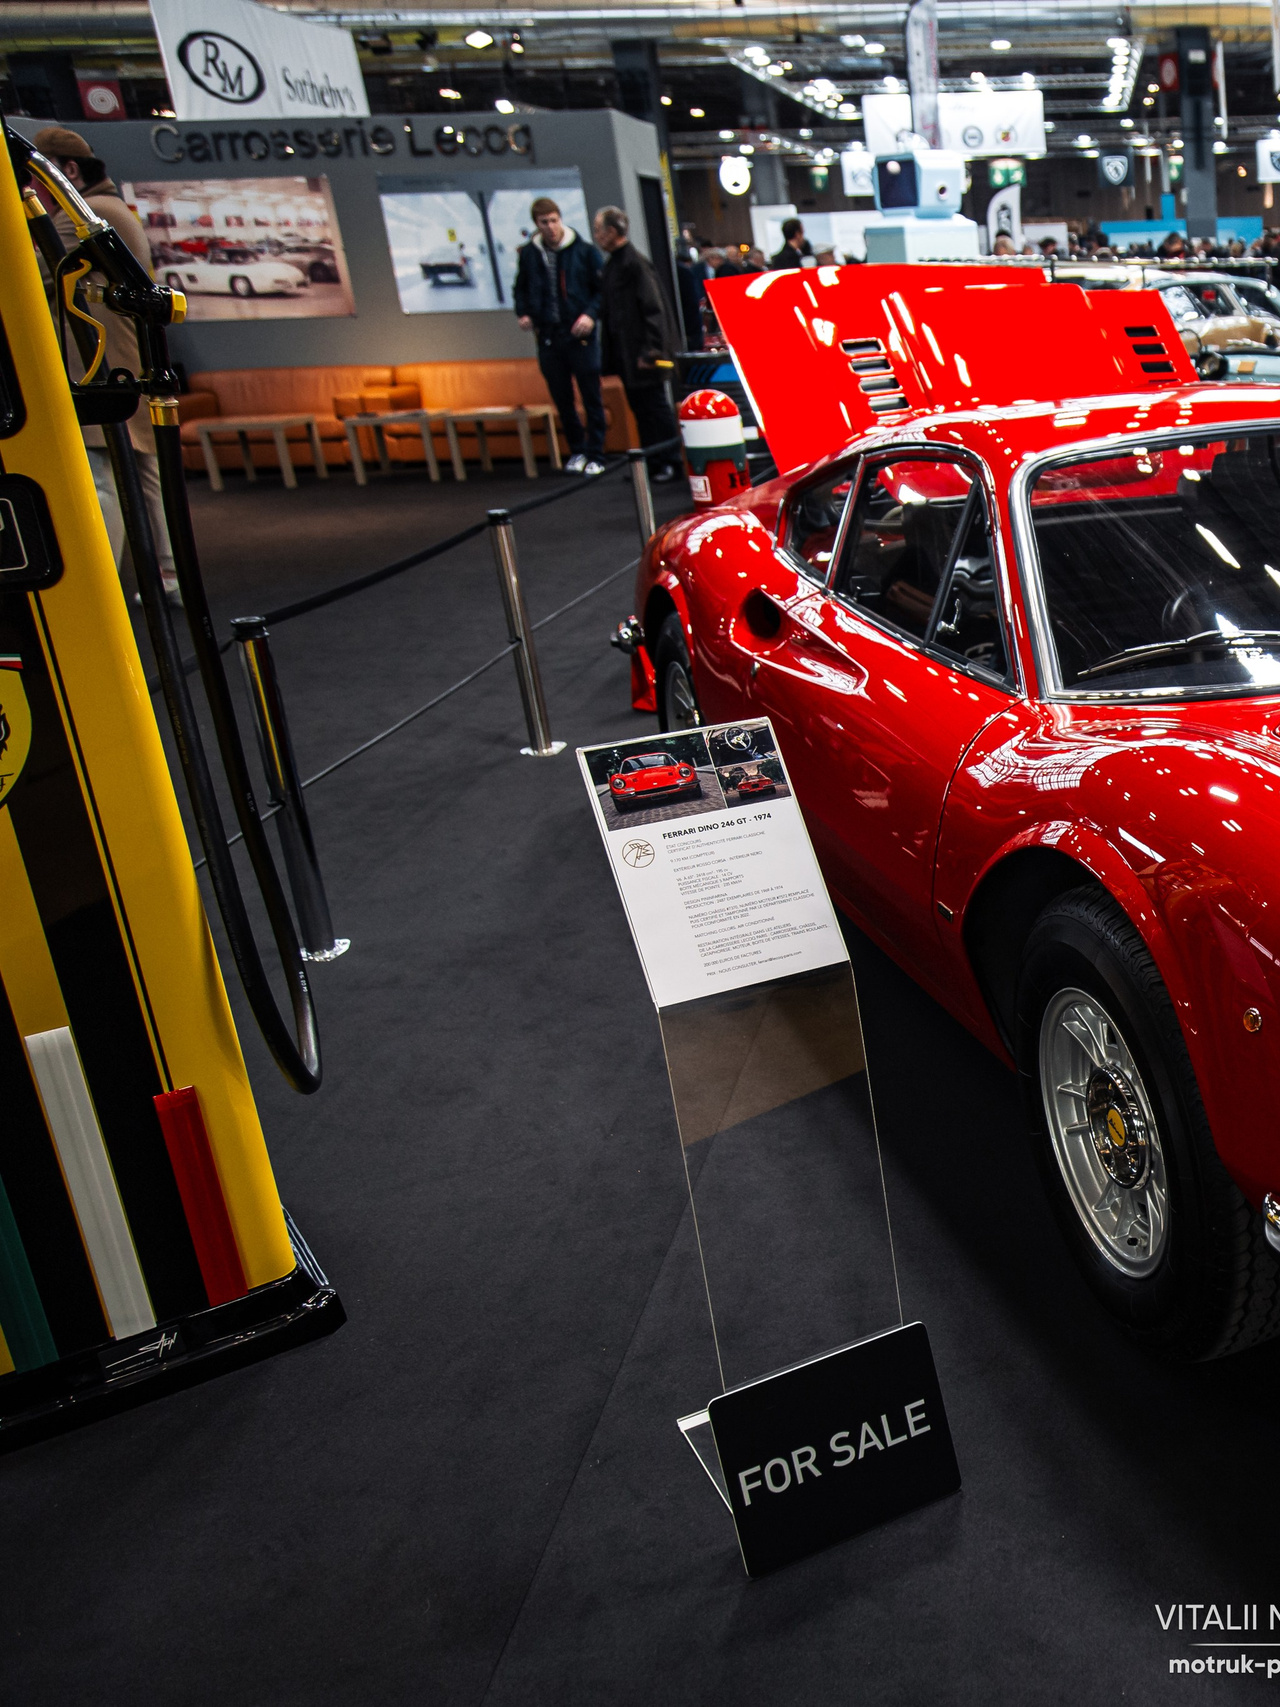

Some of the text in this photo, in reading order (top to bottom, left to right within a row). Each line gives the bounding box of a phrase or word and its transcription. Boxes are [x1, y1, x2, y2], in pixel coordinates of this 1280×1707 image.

[281, 65, 357, 112] Sotheby's
[149, 117, 537, 165] Carrosserie Lecoq
[662, 827, 697, 840] FERRARI
[697, 822, 720, 833] DINO
[720, 819, 736, 828] 246
[736, 817, 748, 825] GT
[753, 812, 772, 822] 1974
[737, 1398, 931, 1507] FOR SALE
